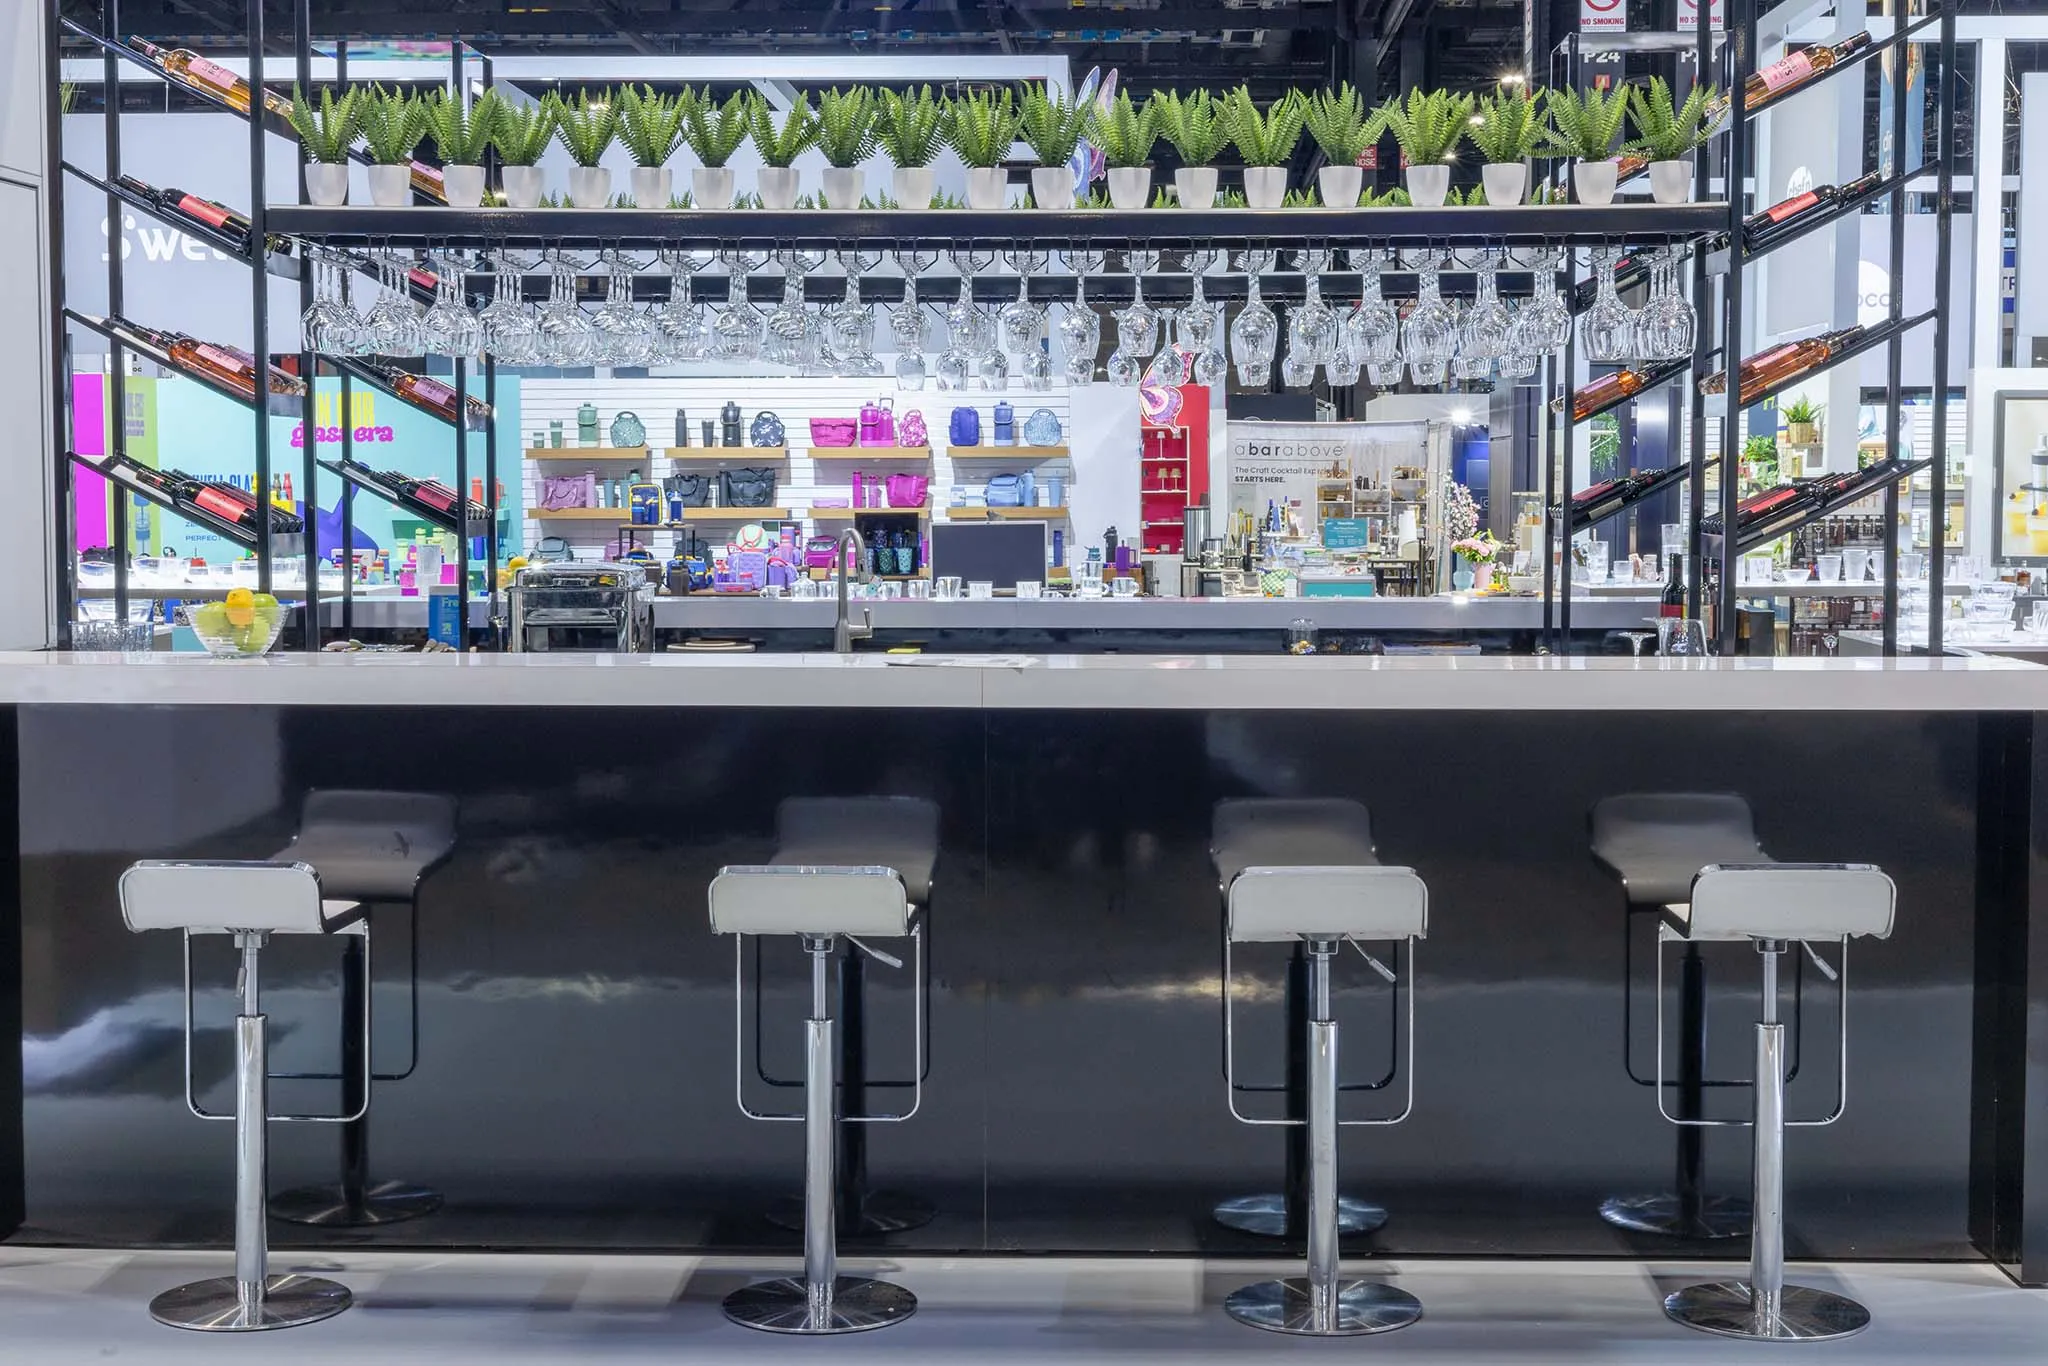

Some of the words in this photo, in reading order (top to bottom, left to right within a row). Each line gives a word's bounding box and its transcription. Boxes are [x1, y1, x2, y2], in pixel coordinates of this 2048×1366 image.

[1581, 17, 1591, 25] NO
[1593, 17, 1625, 25] SMOKING
[1679, 16, 1689, 24] NO
[1584, 51, 1621, 63] P24
[101, 214, 229, 262] S'we
[353, 425, 393, 443] era
[1235, 466, 1248, 474] The
[1250, 466, 1268, 474] Craft
[1271, 466, 1302, 475] Cocktail
[1235, 476, 1263, 484] STARTS
[1265, 476, 1286, 484] HERE.
